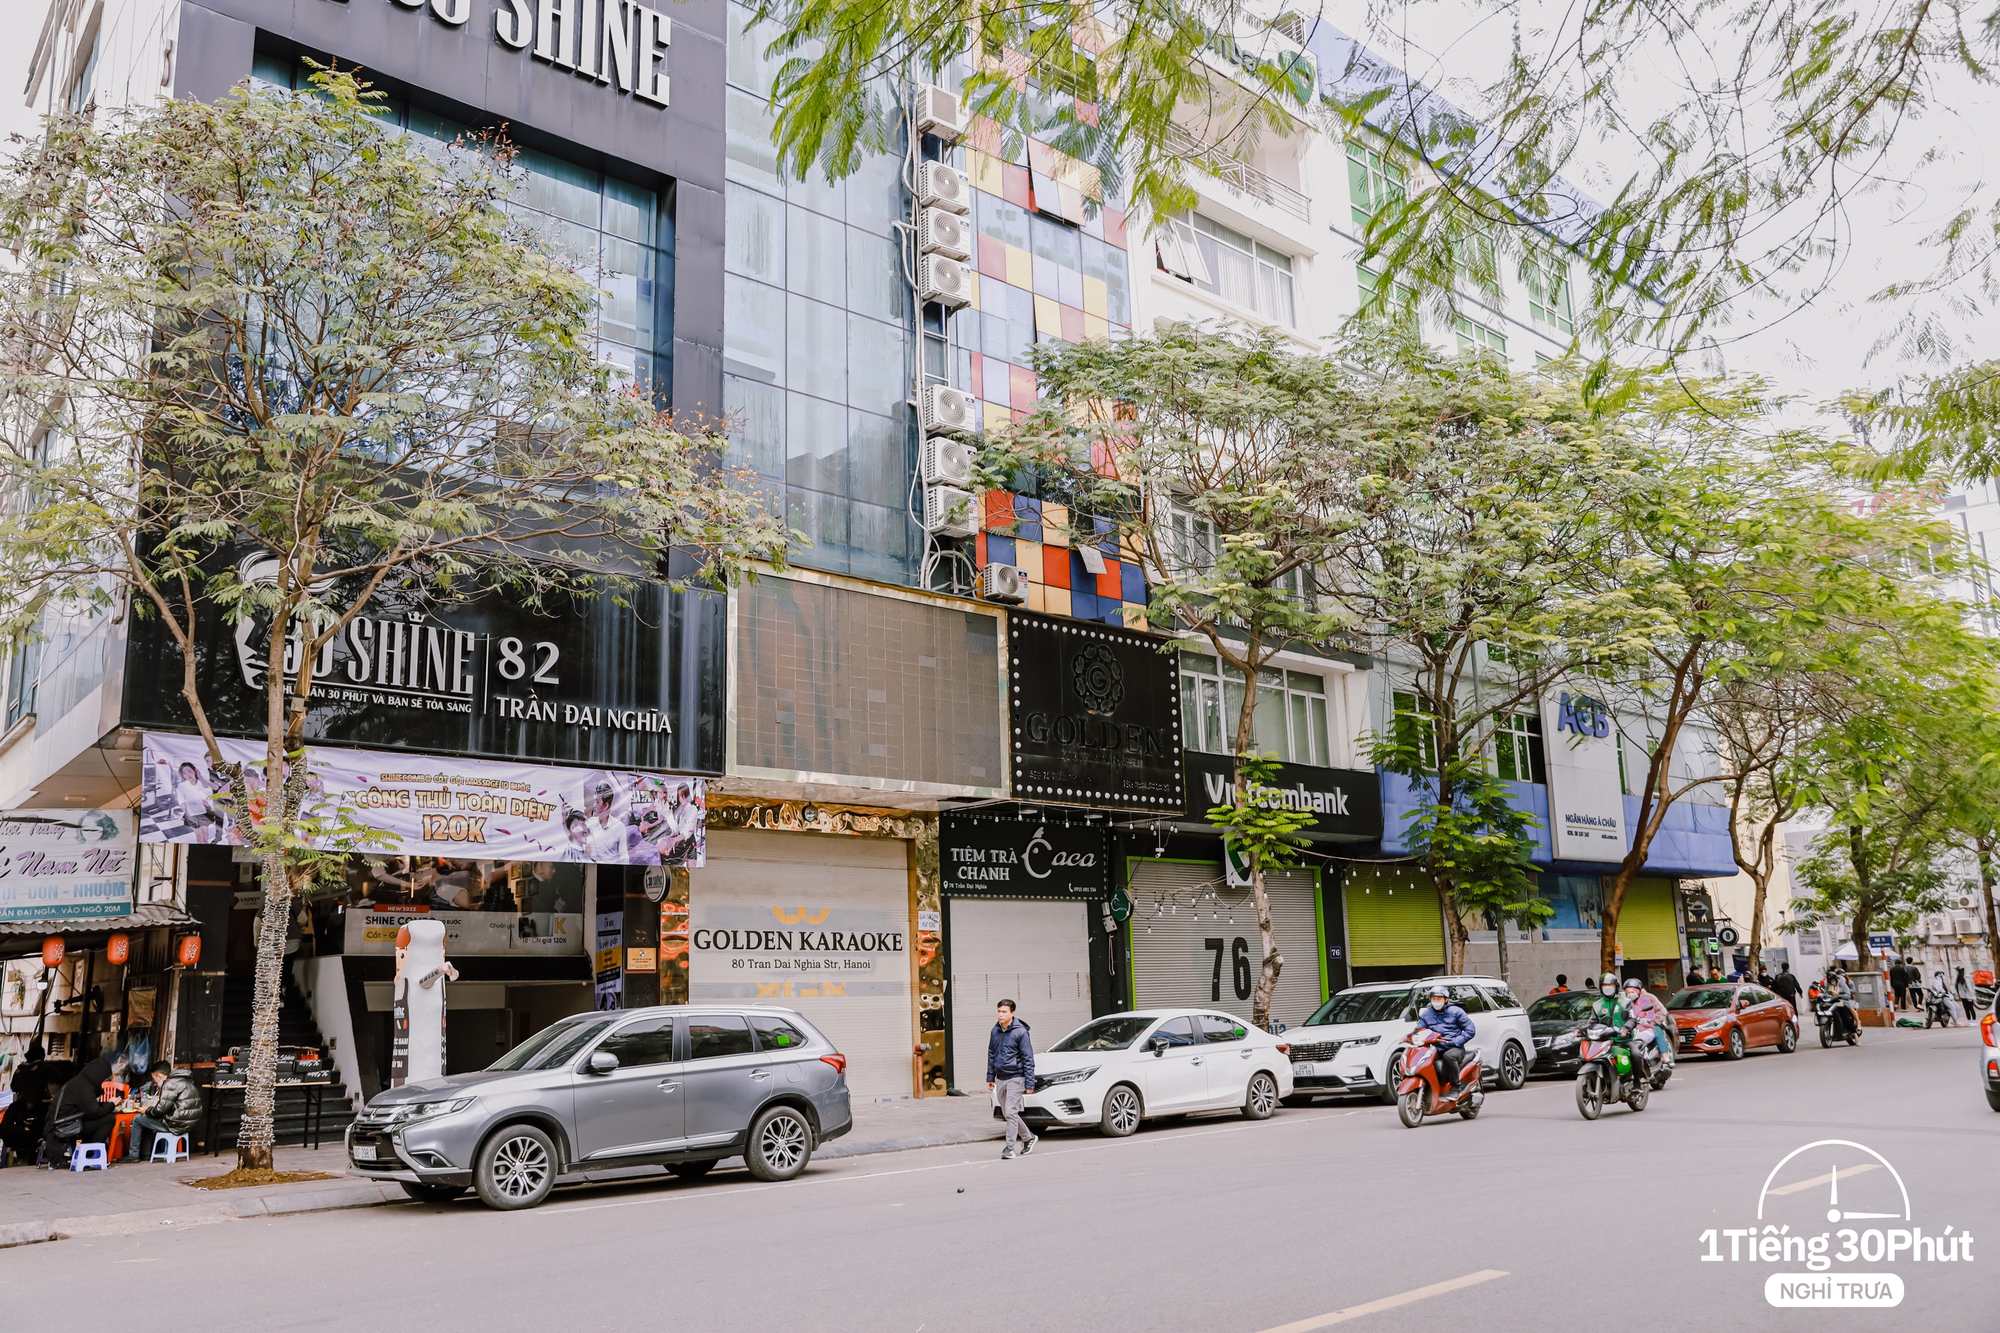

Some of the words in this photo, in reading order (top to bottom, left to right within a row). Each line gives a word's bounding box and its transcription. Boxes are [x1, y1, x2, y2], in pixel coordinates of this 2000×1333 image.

[346, 615, 476, 696] SHINE
[497, 636, 560, 685] 82
[327, 689, 340, 700] 30
[342, 688, 370, 704] PHÚT
[371, 692, 386, 705] VÀ
[387, 695, 410, 708] BẠN
[410, 697, 423, 709] SẼ
[425, 698, 445, 711] TỎA
[446, 700, 473, 714] SÁNG
[495, 688, 558, 723] TRẦN
[564, 703, 601, 731] ĐẠI
[605, 707, 672, 734] NGHĨA
[1557, 692, 1610, 739] ACB
[1025, 711, 1165, 758] GOLDEN
[433, 772, 448, 785] CẮT
[449, 776, 465, 786] GỘI
[465, 778, 500, 789] MASSAGE
[415, 786, 452, 810] THỦ
[456, 791, 507, 815] TOÀN
[421, 813, 487, 844] 120K
[15, 850, 79, 878] Nam
[950, 845, 986, 865] TIỆM
[989, 847, 1019, 864] TRÀ
[957, 865, 1011, 881] CHANH
[73, 878, 126, 901] NHUỘM
[16, 908, 32, 918] ĐẠI
[60, 904, 81, 915] VÀO
[103, 905, 121, 913] 20M
[365, 915, 395, 926] SHINE
[693, 929, 794, 951] GOLDEN
[798, 931, 904, 952] KARAOKE
[731, 958, 745, 969] 80
[747, 958, 772, 969] Tran
[774, 958, 791, 969] Dai
[793, 958, 821, 972] Nghia
[823, 958, 841, 971] Str,
[843, 958, 871, 970] Hanoi
[1204, 936, 1252, 1002] 76
